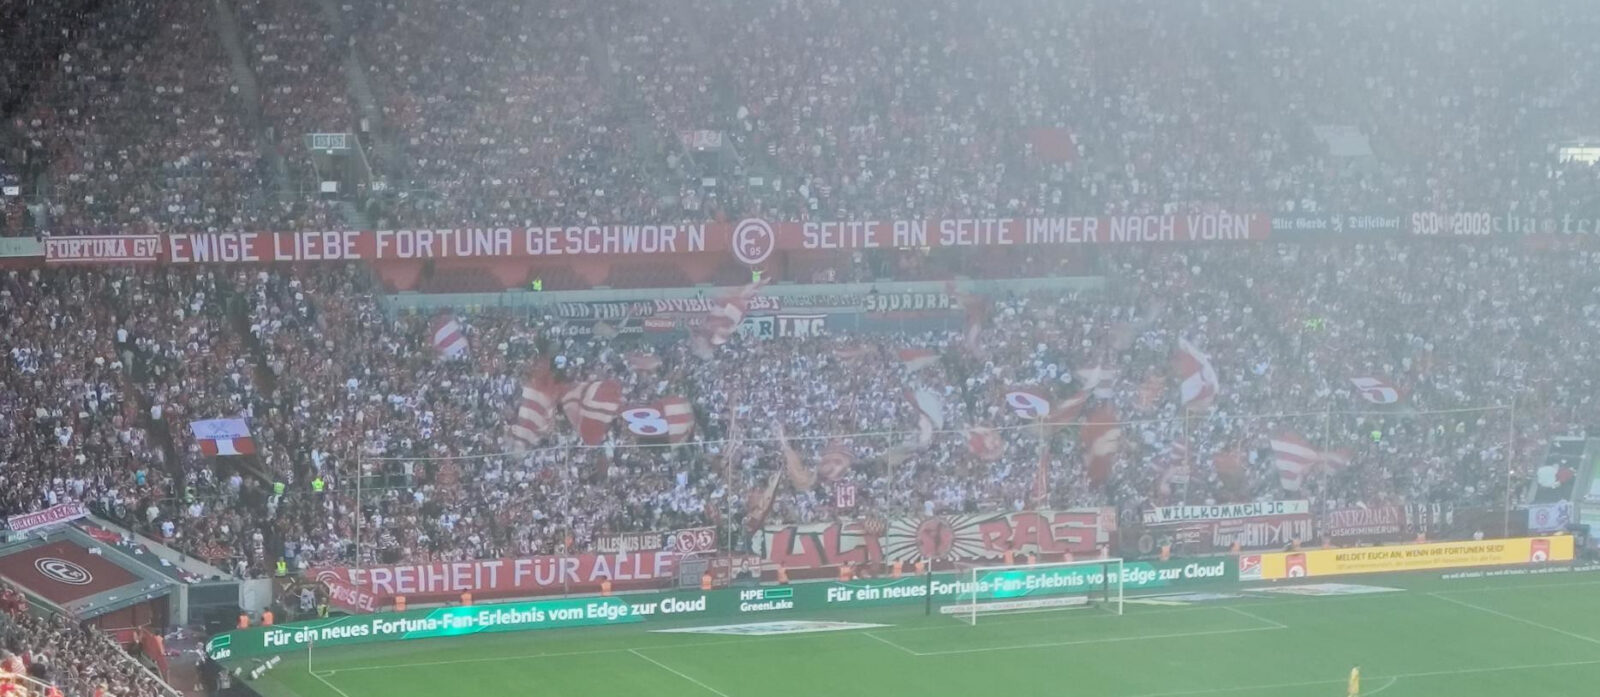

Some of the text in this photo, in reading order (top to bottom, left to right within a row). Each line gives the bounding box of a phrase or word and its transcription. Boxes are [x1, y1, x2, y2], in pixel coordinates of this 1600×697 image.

[803, 213, 1257, 249] SEITE AN SEITE IMMER NACH VORN'
[1412, 212, 1490, 235] SCD 2003
[46, 238, 126, 259] FORTUNA
[171, 225, 705, 263] EWIGE LIEBE FORTUNA GESCHWOR'N
[867, 293, 949, 311] SQUADRA
[1005, 392, 1049, 420] 9
[622, 408, 668, 435] 8
[1161, 503, 1262, 519] WILLKOMMEN
[597, 537, 621, 553] ALLES
[623, 536, 639, 552] AUS
[640, 534, 661, 551] LIEBE
[1335, 552, 1365, 562] MELDET
[1367, 551, 1389, 561] EUCH
[1406, 549, 1429, 558] WENN
[1444, 545, 1485, 556] FORTUNEN
[348, 560, 503, 596] FREIHEIT
[515, 555, 580, 587] FÜR
[588, 551, 674, 582] ALLE
[828, 586, 854, 601] Für
[857, 583, 880, 599] ein
[883, 582, 927, 597] neues
[931, 571, 1083, 596] Fortuna-Fan-Erlebnis
[1087, 572, 1118, 584] vom
[1121, 567, 1156, 585] Edge
[1159, 565, 1182, 580] zur
[1184, 561, 1225, 578] Cloud
[740, 590, 794, 612] HPE GreenLake
[263, 595, 706, 647] Für ein neues Fortuna-Fan-Erlebnis vom Edge zur Cloud
